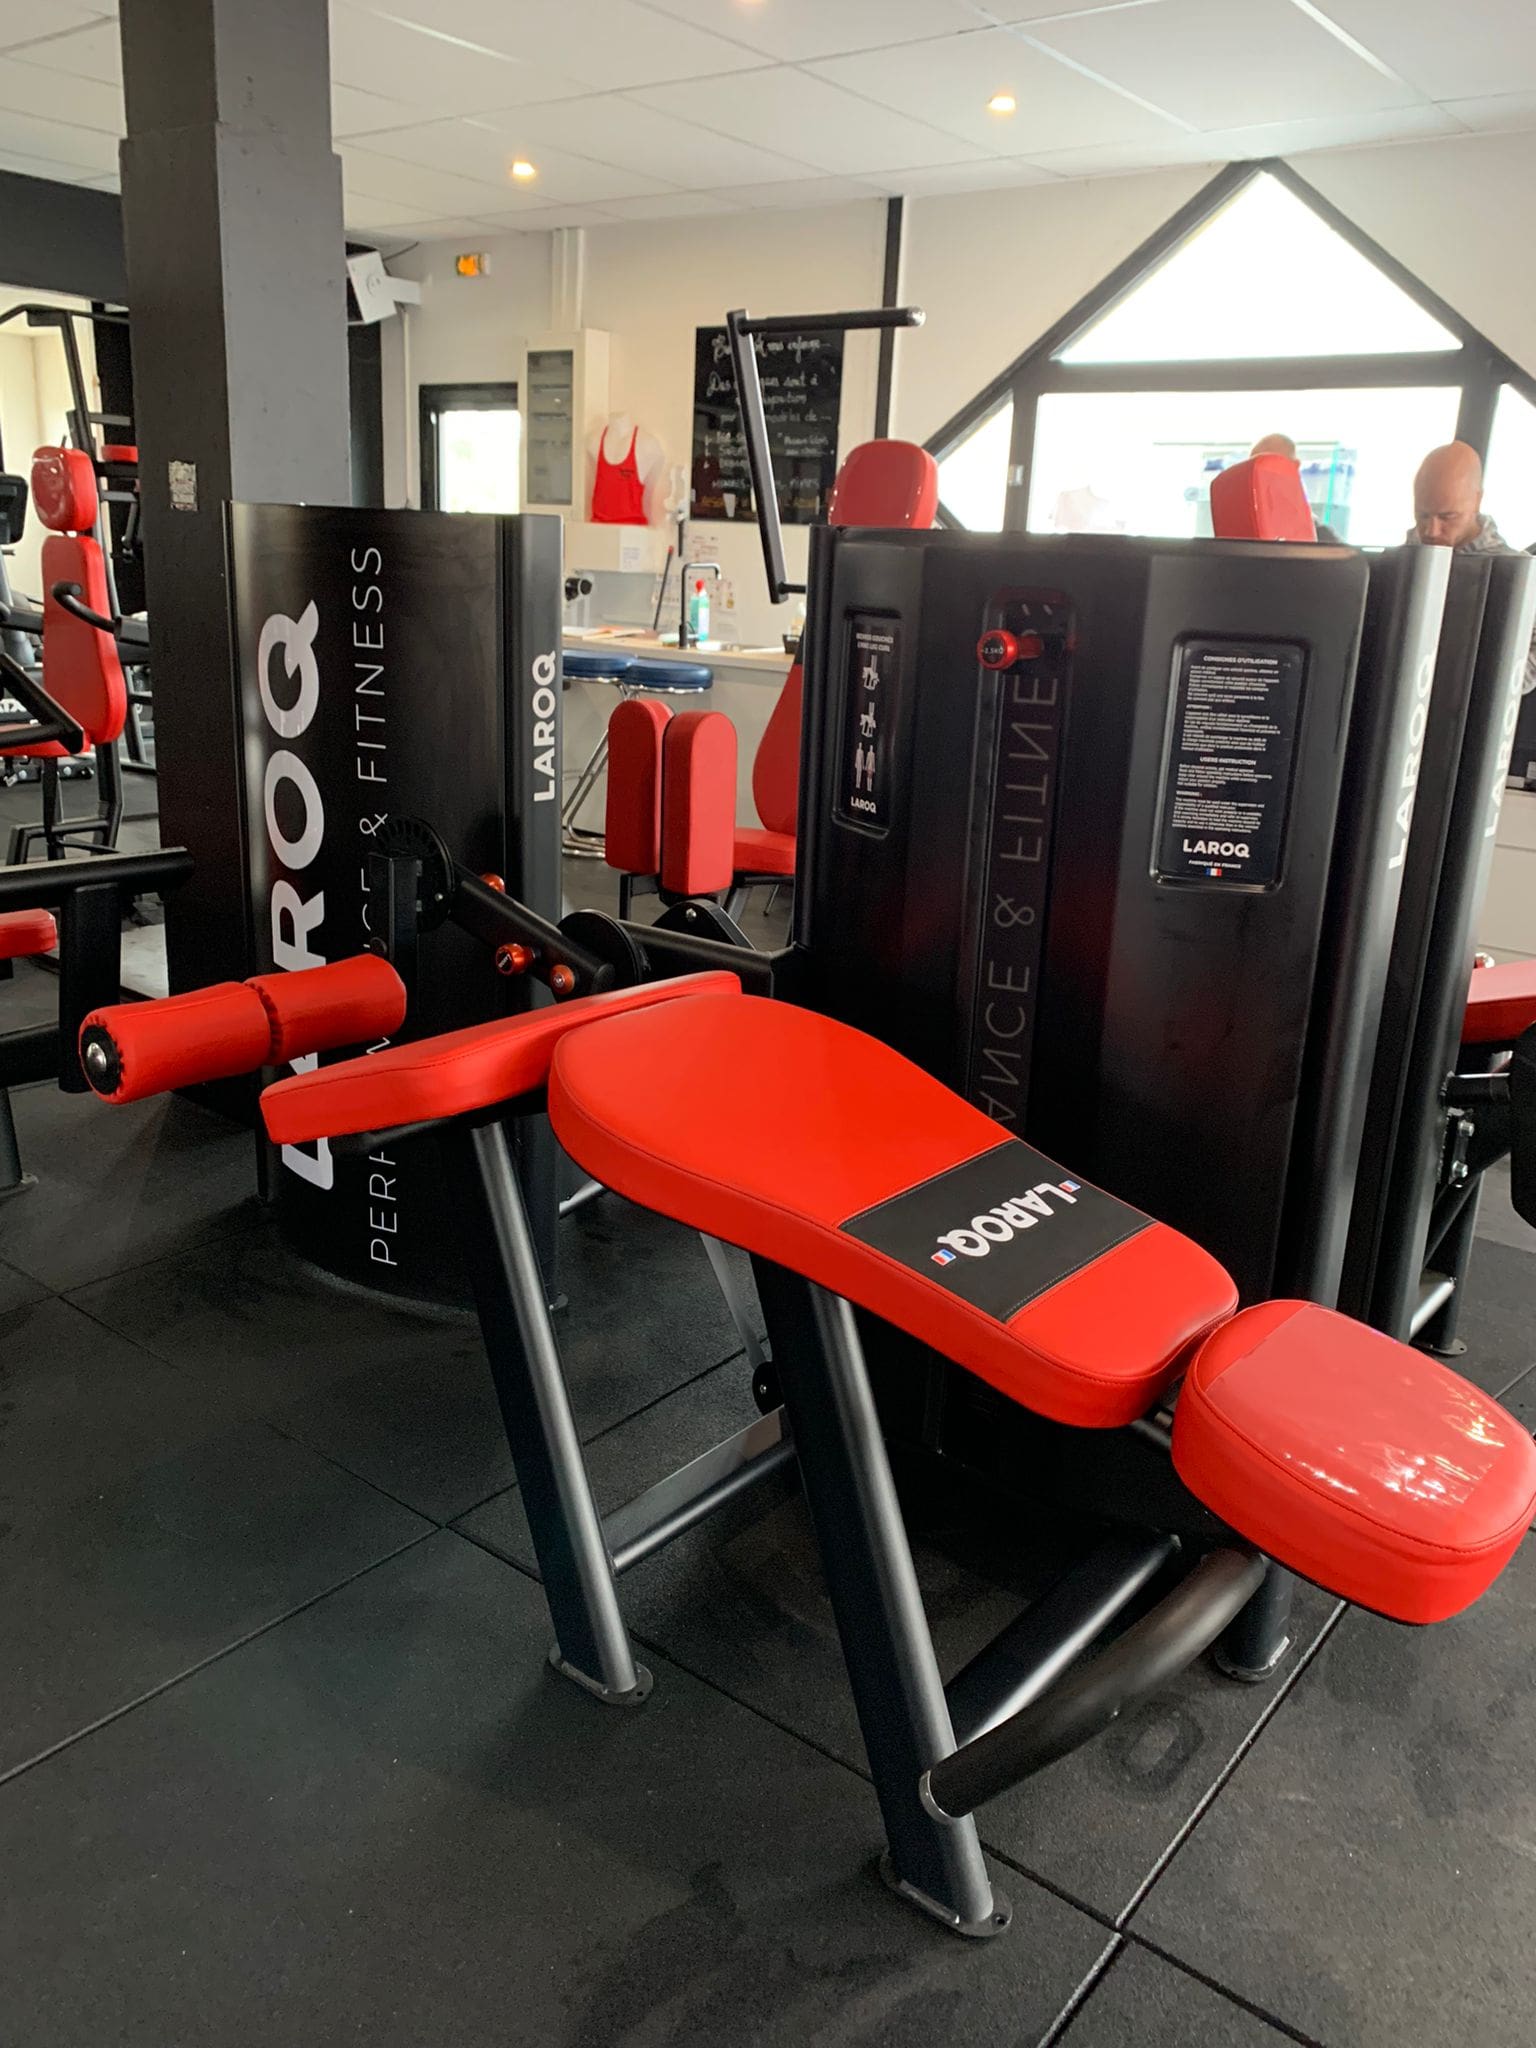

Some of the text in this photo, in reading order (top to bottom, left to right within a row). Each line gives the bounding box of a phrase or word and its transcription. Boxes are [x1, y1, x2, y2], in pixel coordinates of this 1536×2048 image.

[351, 547, 388, 784] FITNESS
[531, 649, 557, 803] LAROQ
[850, 796, 877, 814] LAROQ
[1389, 653, 1437, 870] LAROQ
[259, 599, 334, 1192] LROQ
[1183, 838, 1251, 859] LAROQ
[936, 1182, 1079, 1258] LAROQ
